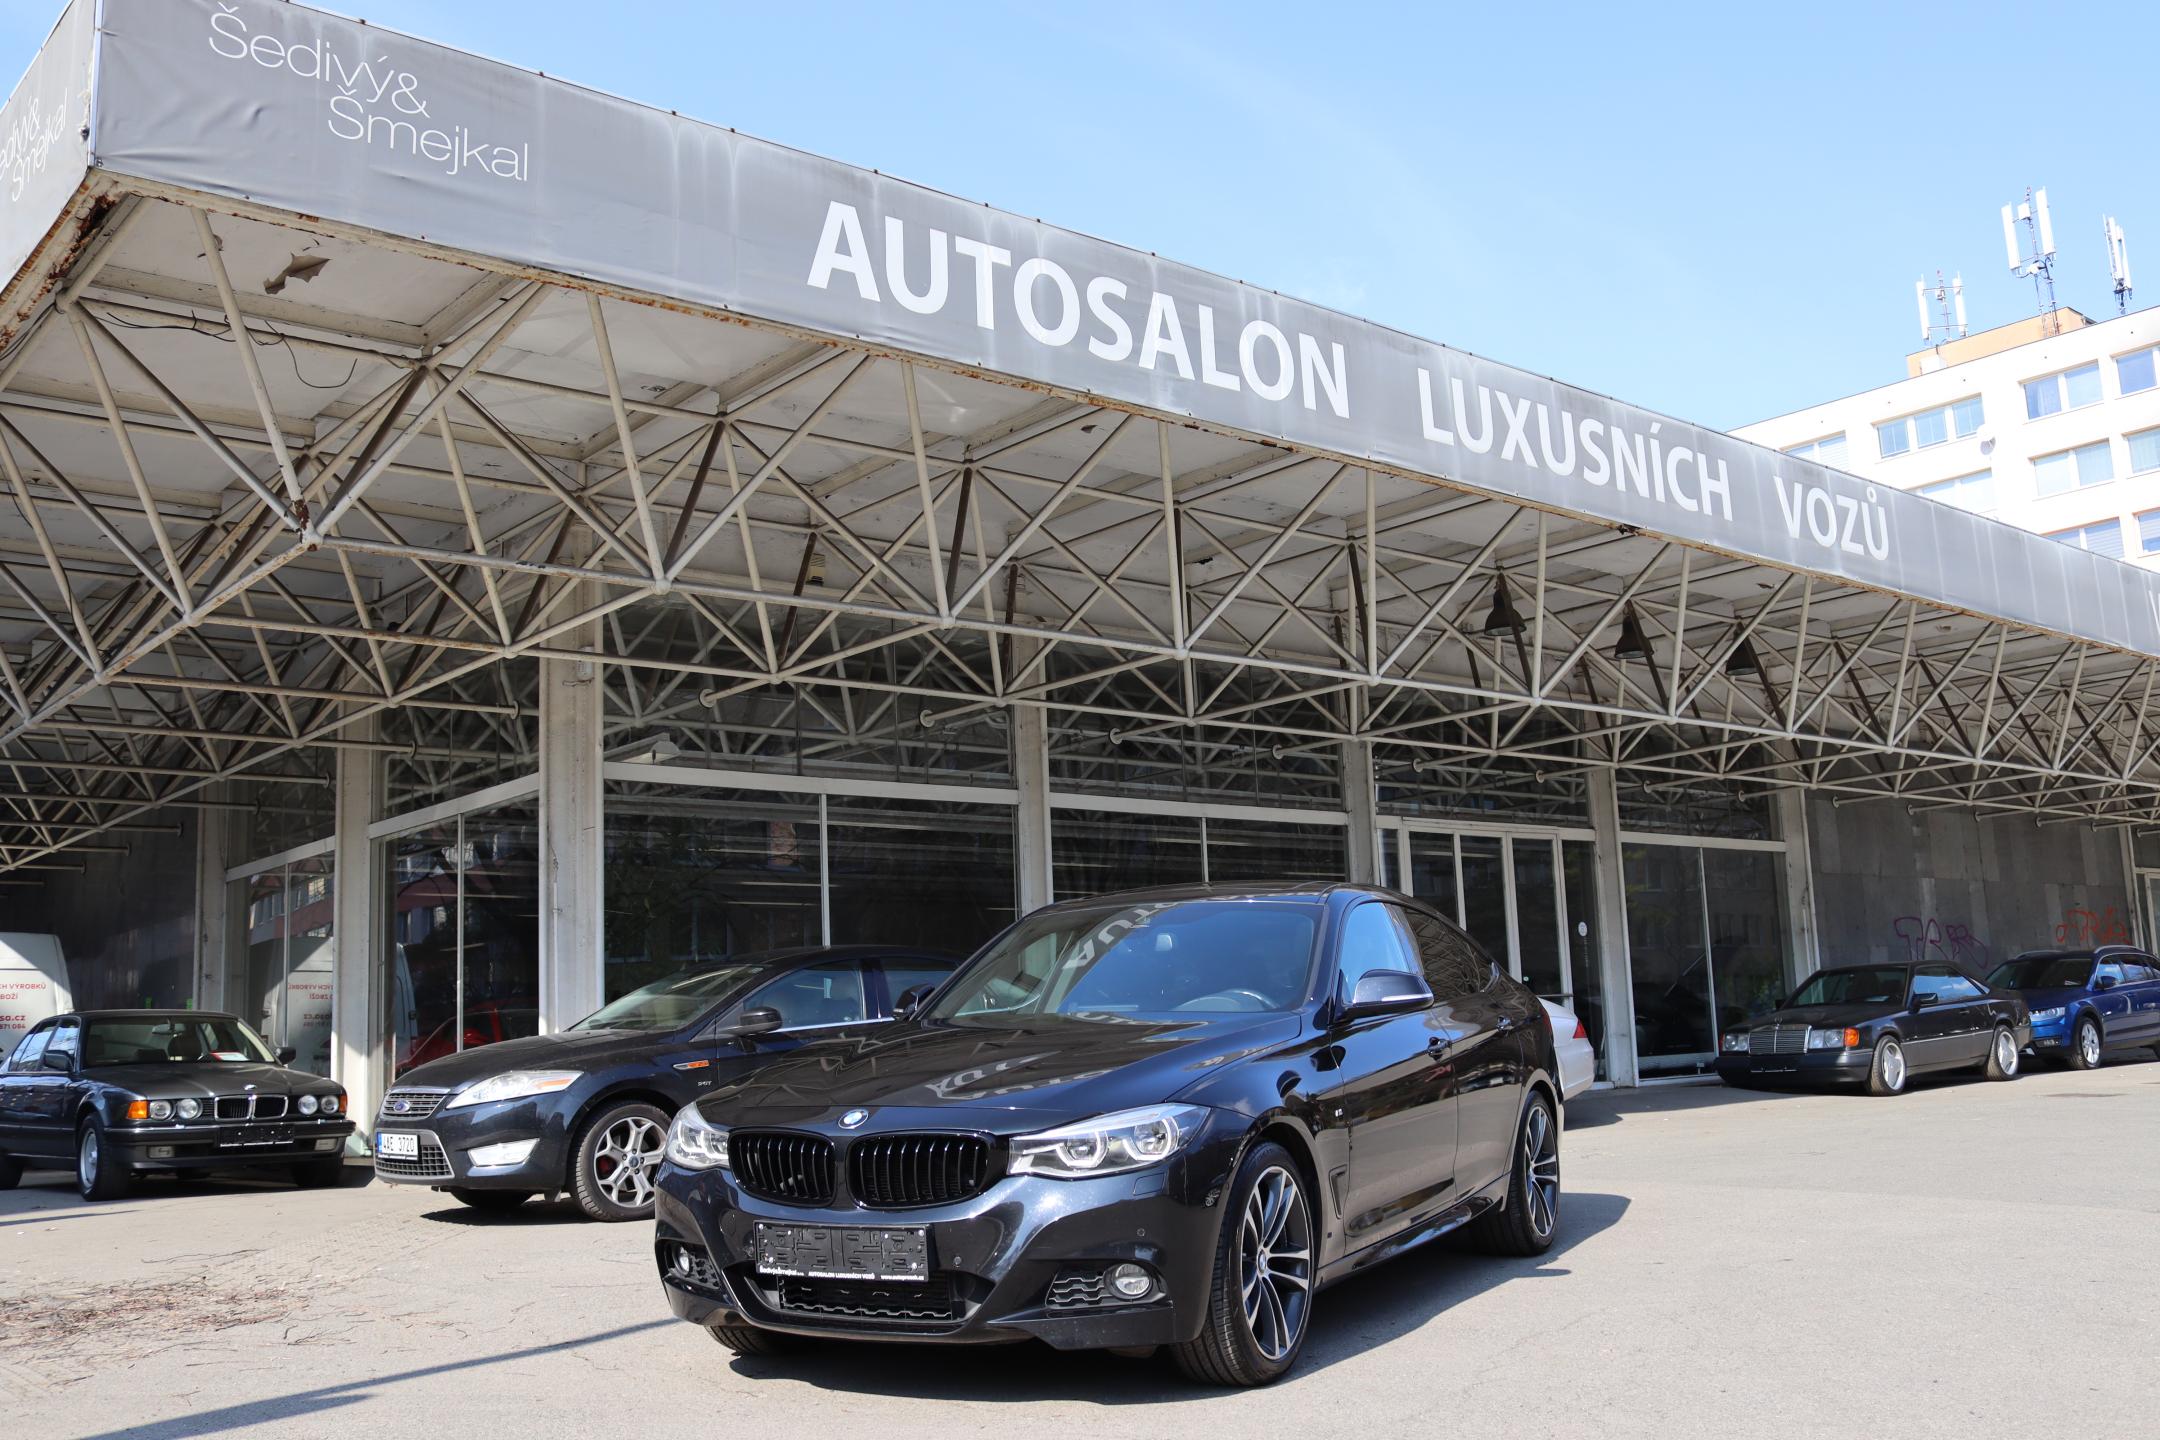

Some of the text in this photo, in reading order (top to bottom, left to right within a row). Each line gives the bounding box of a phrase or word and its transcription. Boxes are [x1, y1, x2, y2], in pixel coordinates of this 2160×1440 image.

[209, 1, 430, 118] Šedivý&
[328, 84, 528, 181] Šmejkal
[806, 200, 1889, 561] AUTOSALON LUXUSNÍCH VOZŮ
